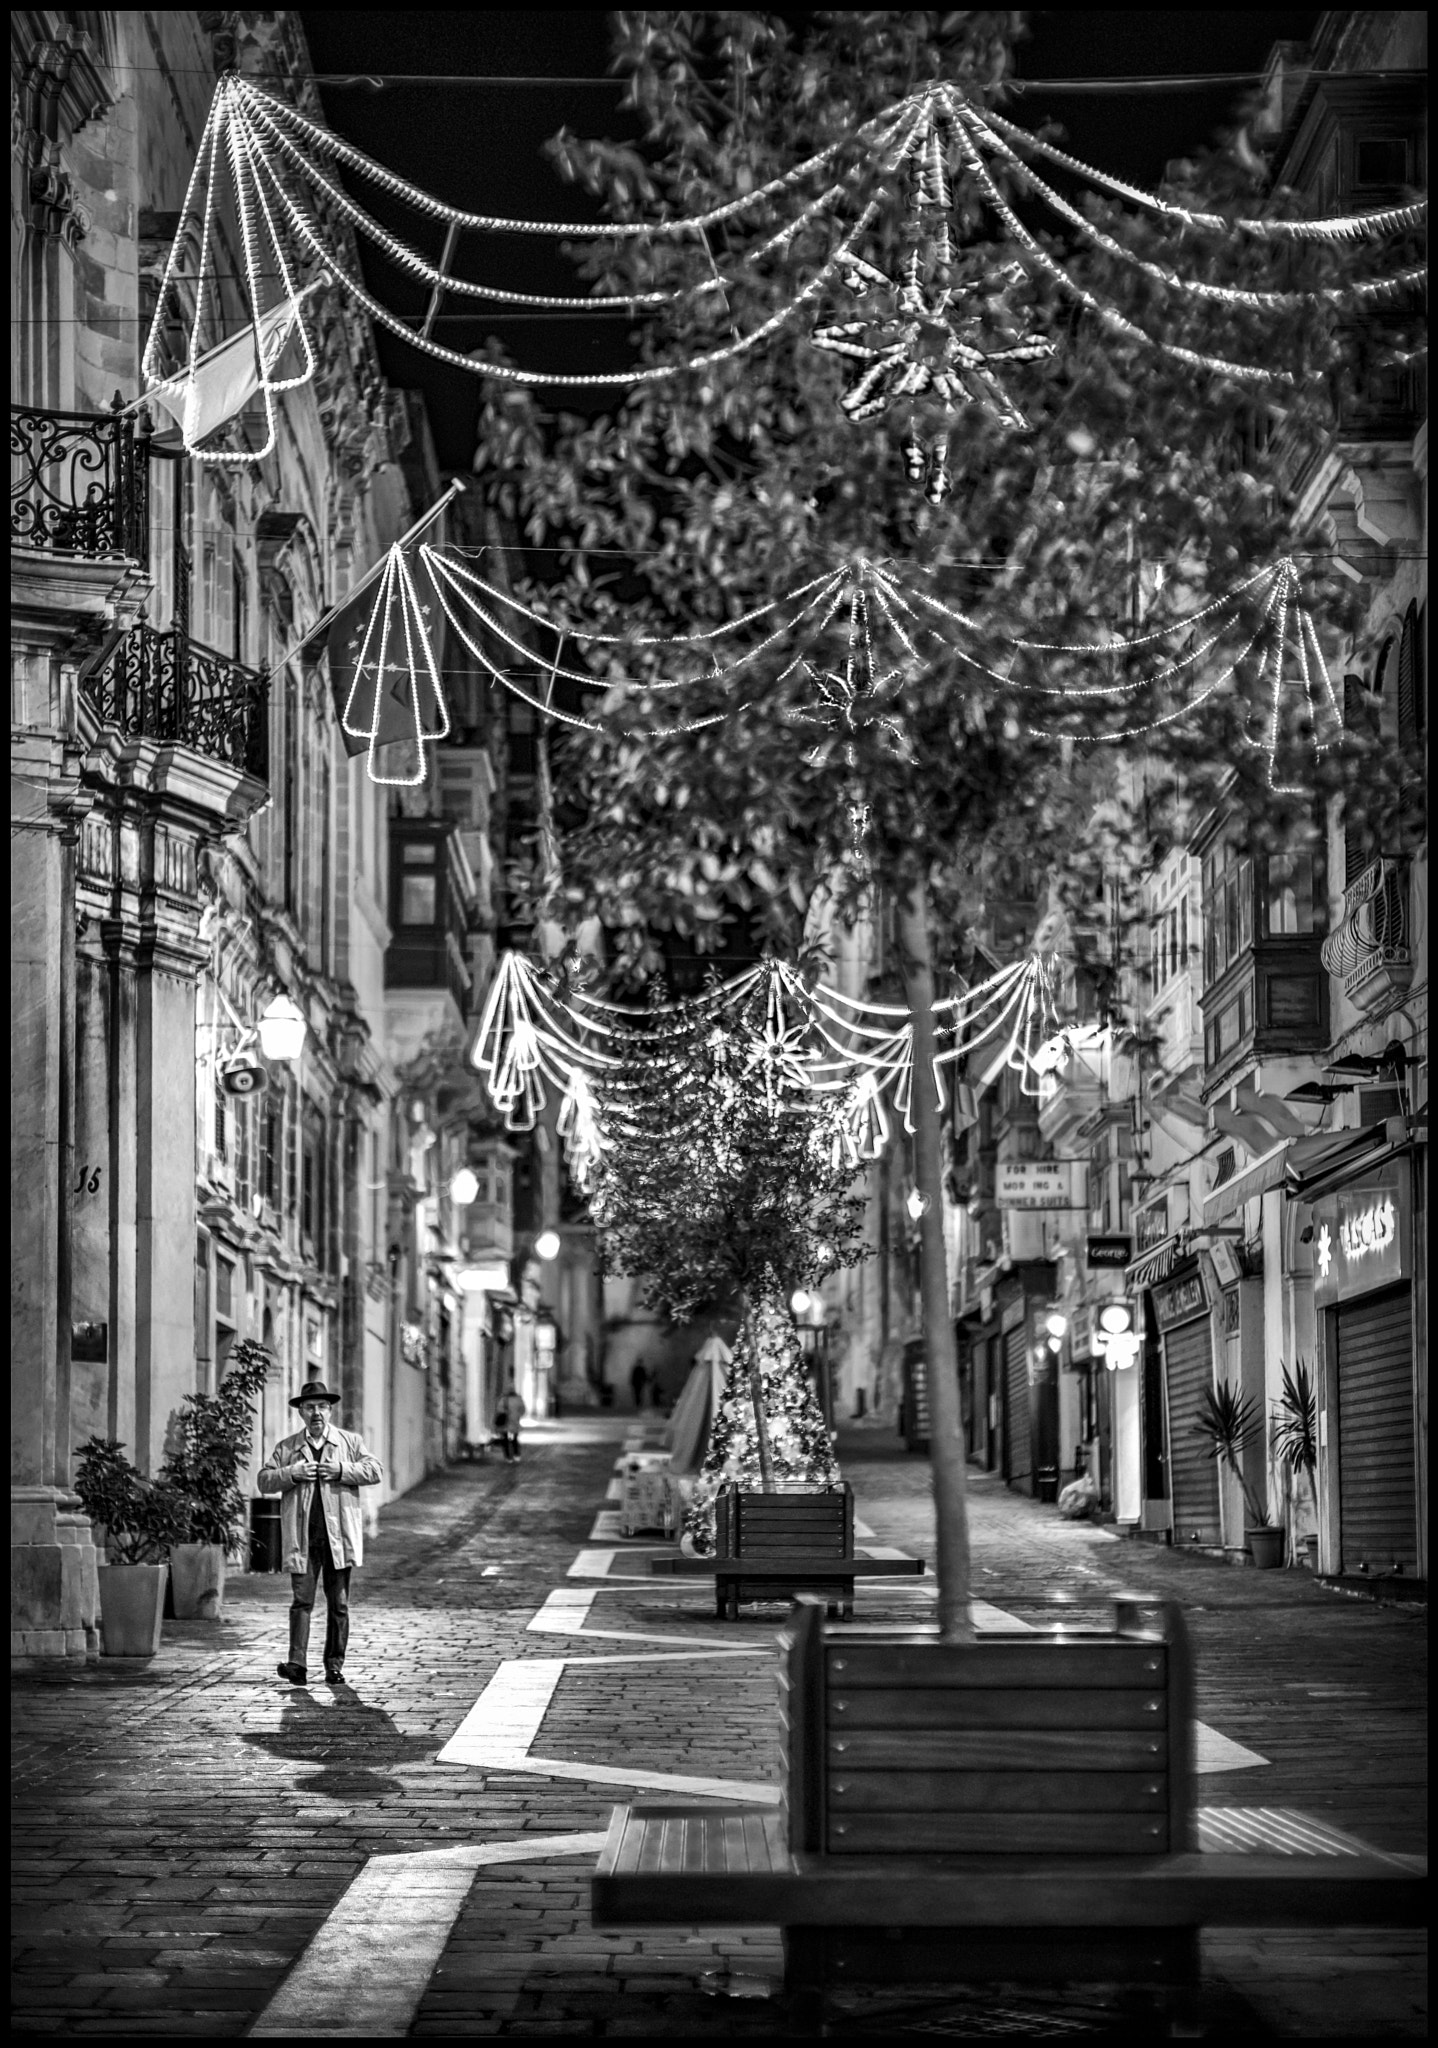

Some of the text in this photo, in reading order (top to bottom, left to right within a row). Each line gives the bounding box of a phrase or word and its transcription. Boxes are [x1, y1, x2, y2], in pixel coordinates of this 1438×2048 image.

[1006, 1165, 1059, 1175] FOR HIRE
[1040, 1196, 1070, 1208] SUITS
